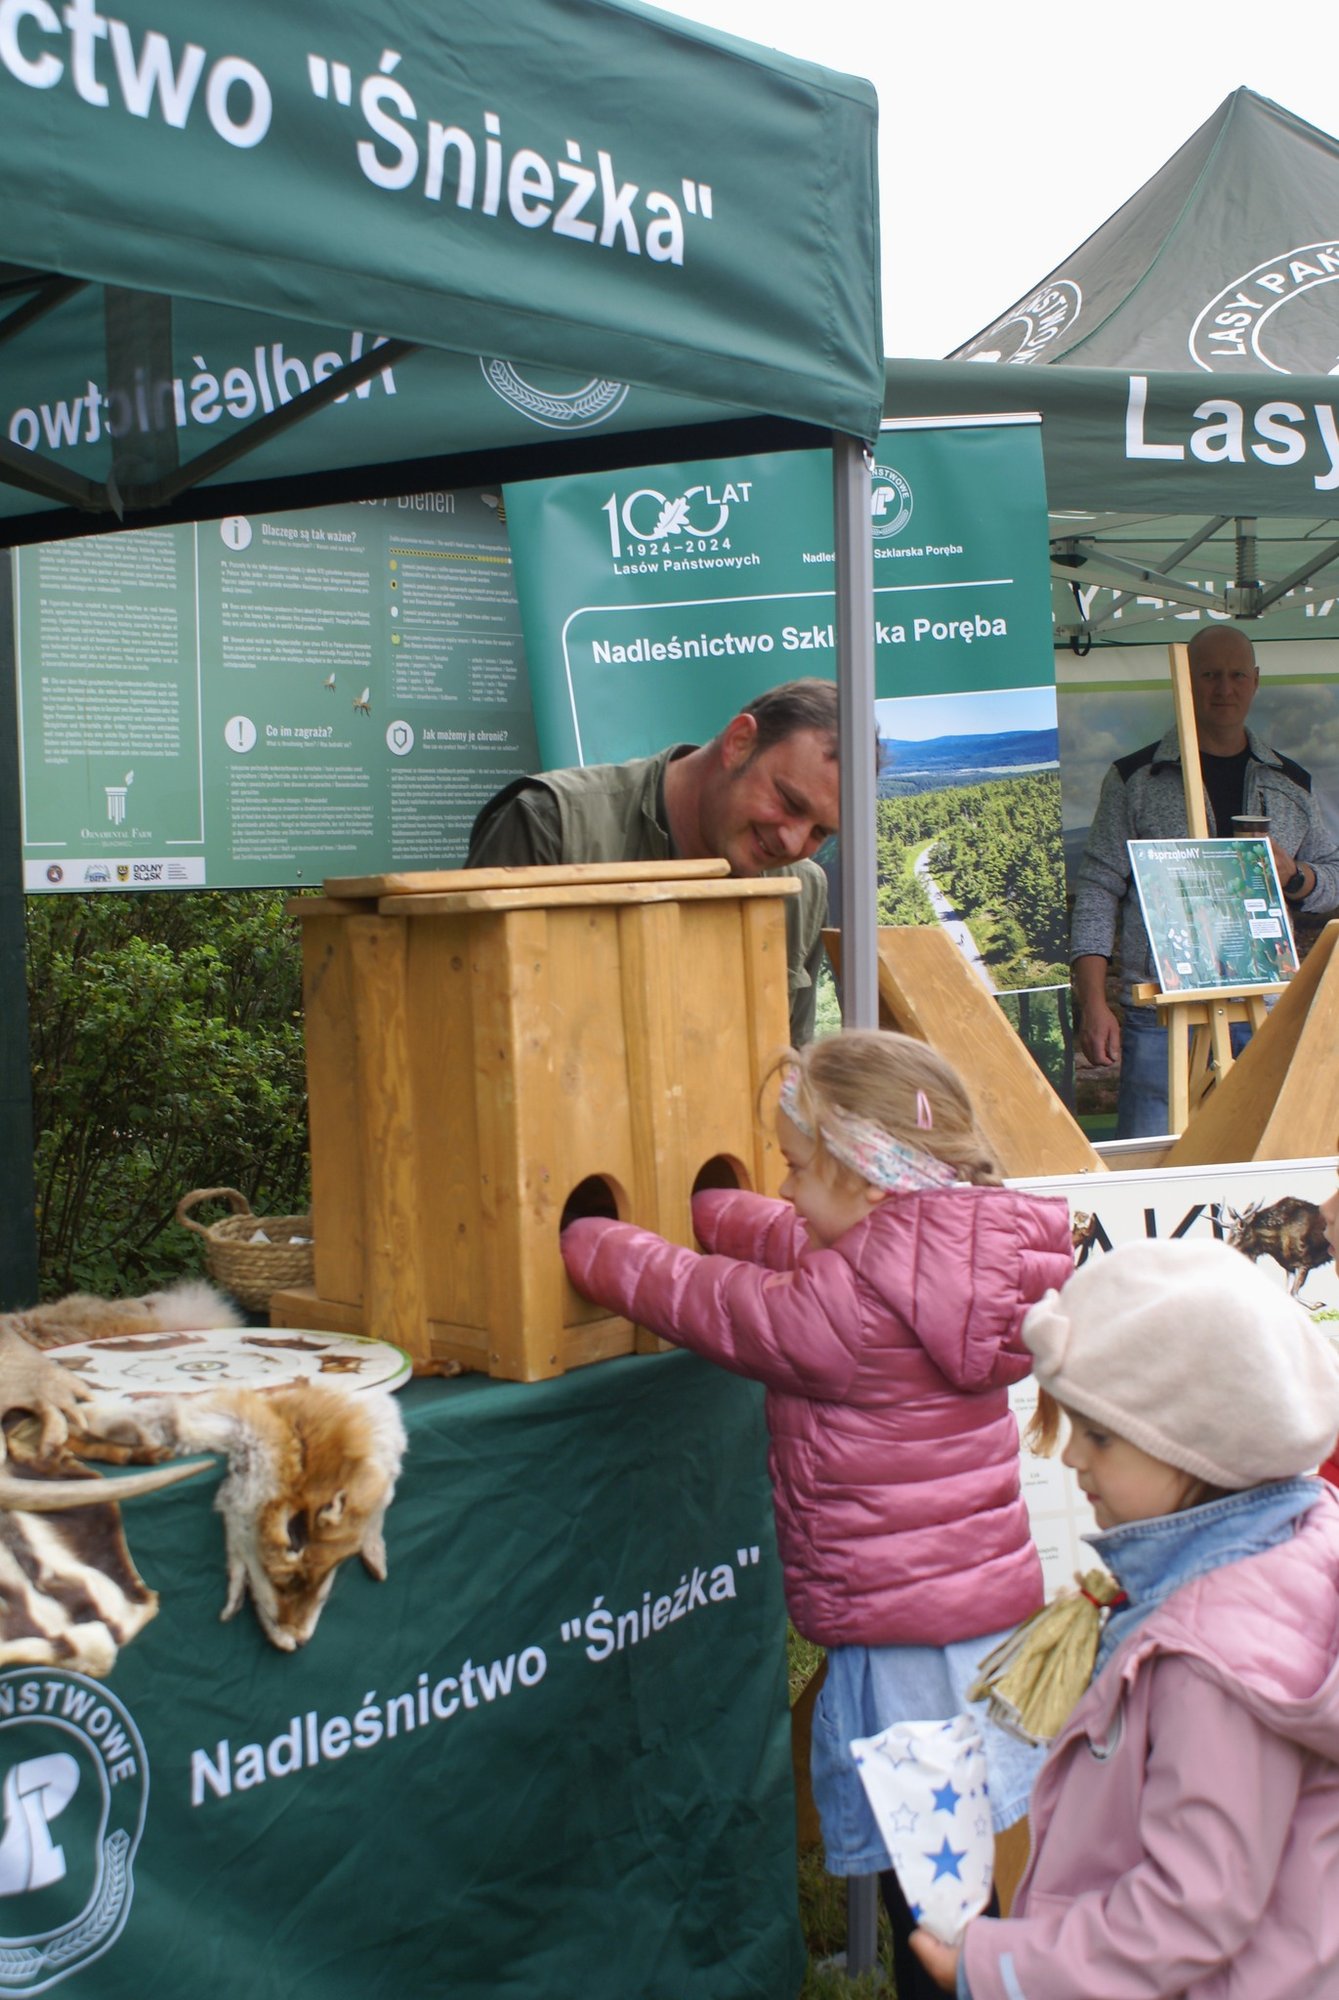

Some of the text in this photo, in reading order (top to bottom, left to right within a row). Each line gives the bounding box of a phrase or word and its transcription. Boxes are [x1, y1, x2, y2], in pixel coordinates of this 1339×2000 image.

[308, 49, 714, 267] "Śnieżka"
[1208, 292, 1264, 356] LASY
[705, 482, 753, 505] LAT
[261, 523, 357, 543] Dlaczego są tak ważne?
[613, 553, 761, 575] Lasów Państwowych
[802, 544, 964, 563] Nadleś Szklarska Poręba
[592, 615, 1007, 665] Nadleśnictwo Szklka Poręba
[266, 724, 334, 739] Co im zagraża?
[422, 729, 509, 742] Jak możemy je chronić?
[133, 864, 163, 873] DOLNY
[190, 1545, 760, 1807] Nadleśnictwo "Śnieżka"
